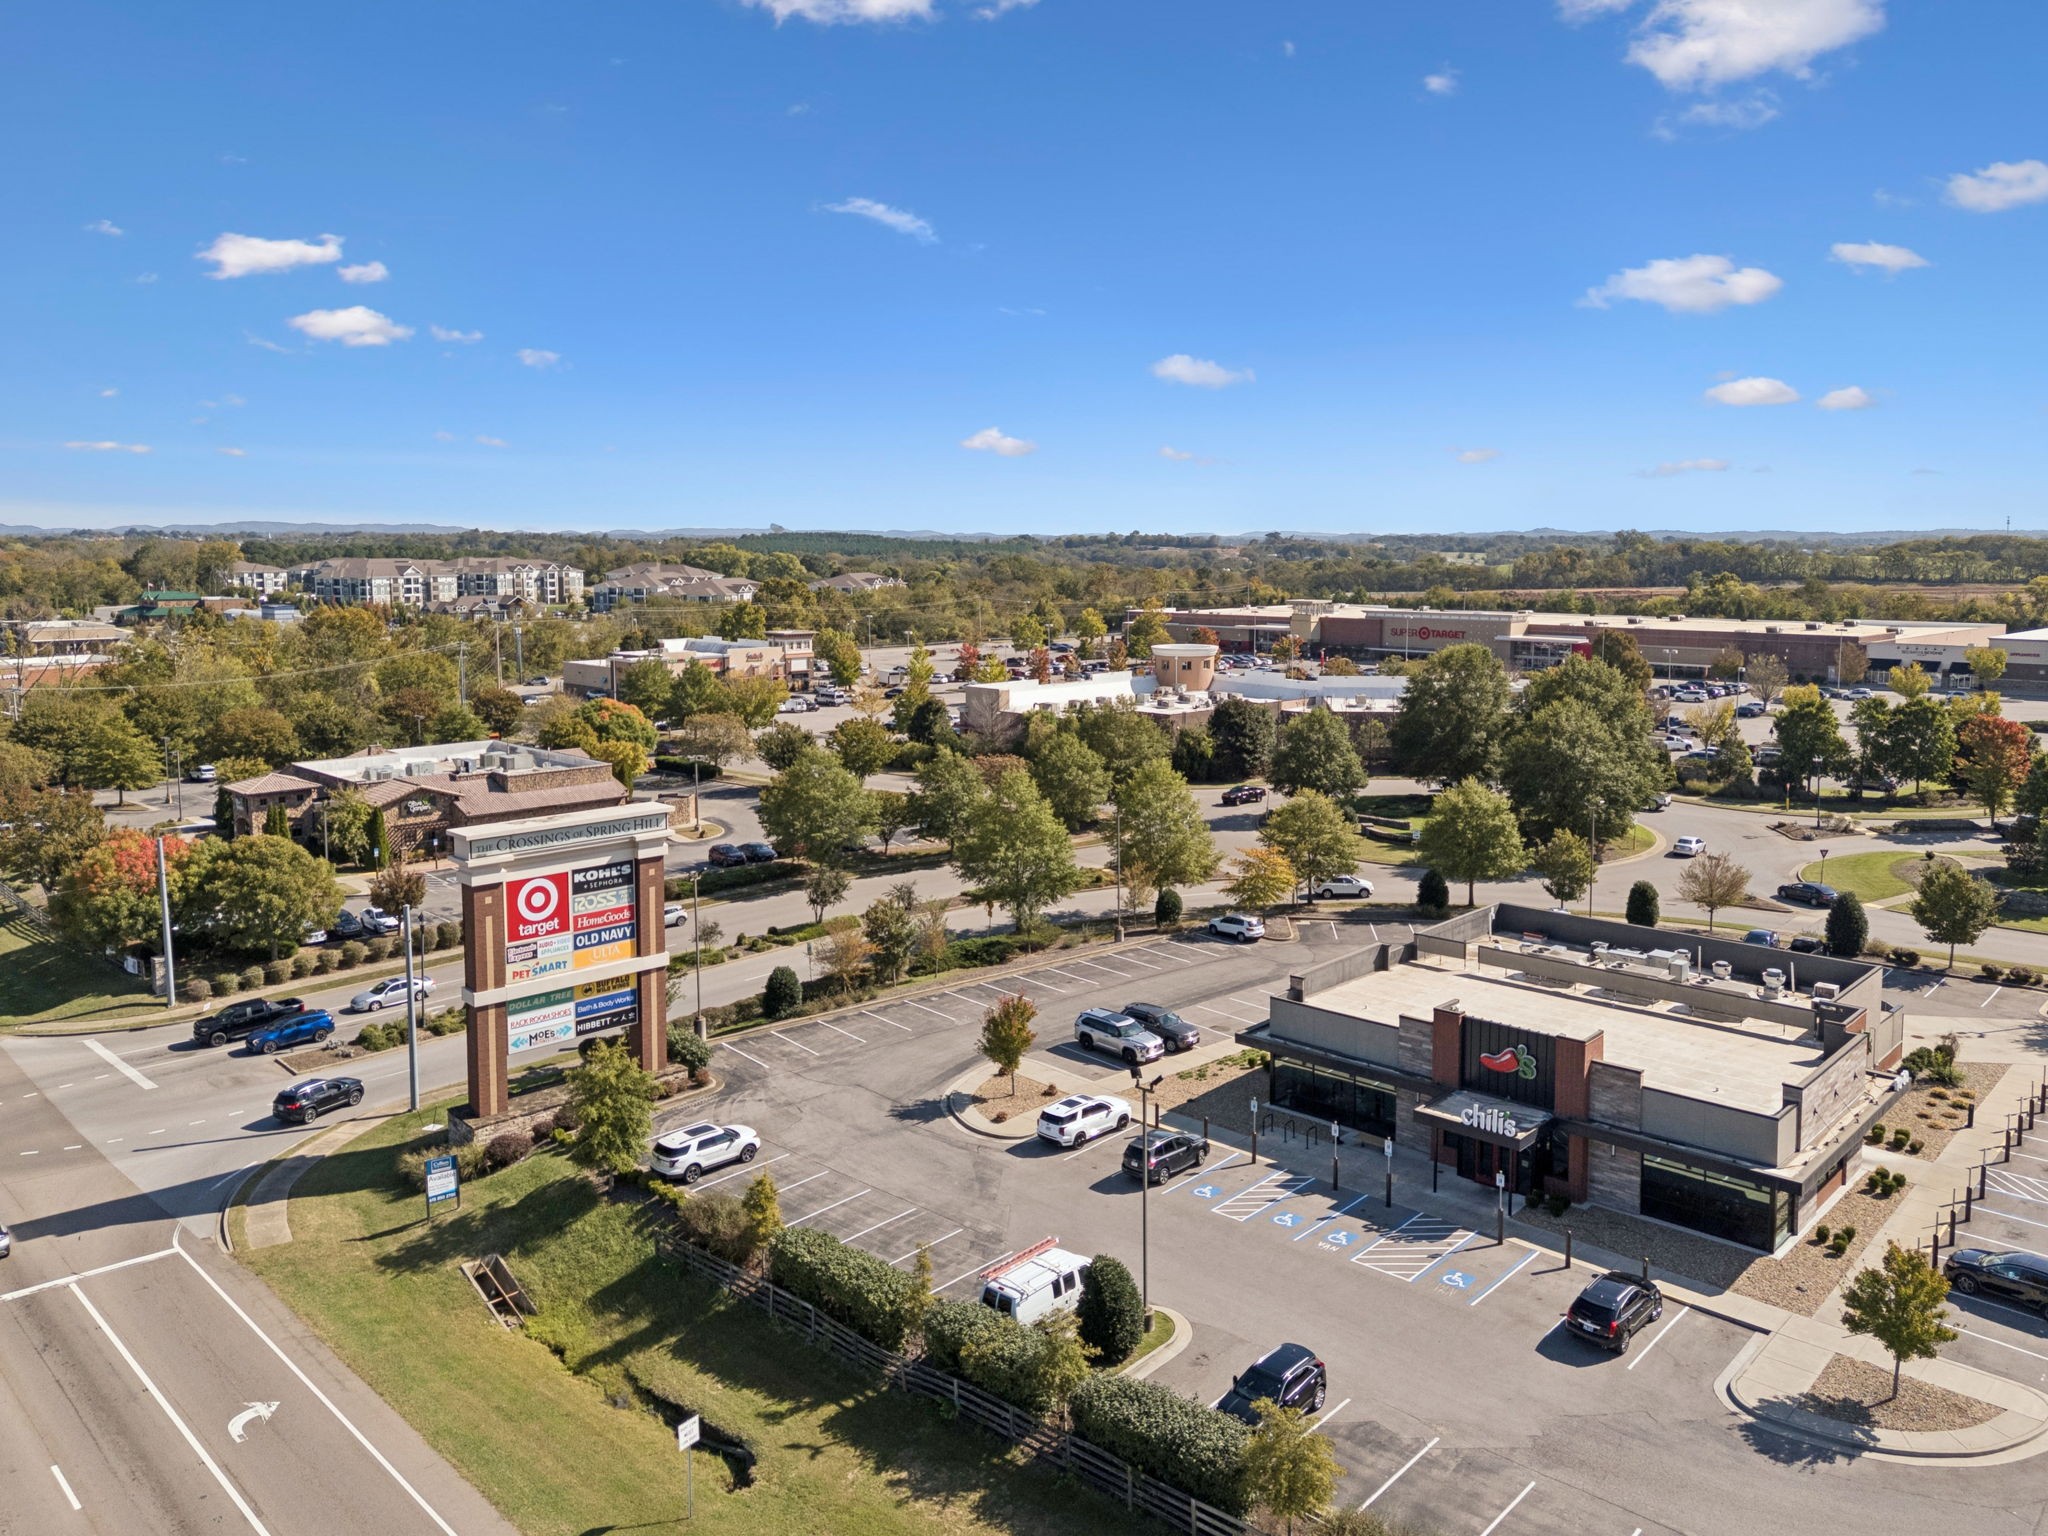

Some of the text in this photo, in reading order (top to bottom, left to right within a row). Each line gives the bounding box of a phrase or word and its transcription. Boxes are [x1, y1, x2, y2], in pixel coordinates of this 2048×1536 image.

[1390, 627, 1467, 639] SUPER TARGET
[476, 816, 662, 854] THE CROSSINGS OF SPRING HILL
[573, 864, 632, 883] KOHL'S
[589, 878, 623, 889] SEPHORA
[574, 890, 617, 912] ROSS
[518, 917, 560, 936] target
[577, 909, 631, 928] HomeGoods
[576, 925, 633, 948] OLD NAVY
[592, 945, 620, 959] ULTA
[596, 974, 630, 987] BUFFALO
[508, 989, 572, 1010] DOLLAR TREE
[577, 1004, 593, 1014] Bath
[598, 1000, 614, 1009] Body
[613, 996, 634, 1005] Works
[510, 1008, 572, 1029] RACK ROOM SHOES
[577, 1017, 611, 1032] HIBBETT
[428, 1171, 457, 1183] Available
[1317, 1241, 1341, 1252] VAN
